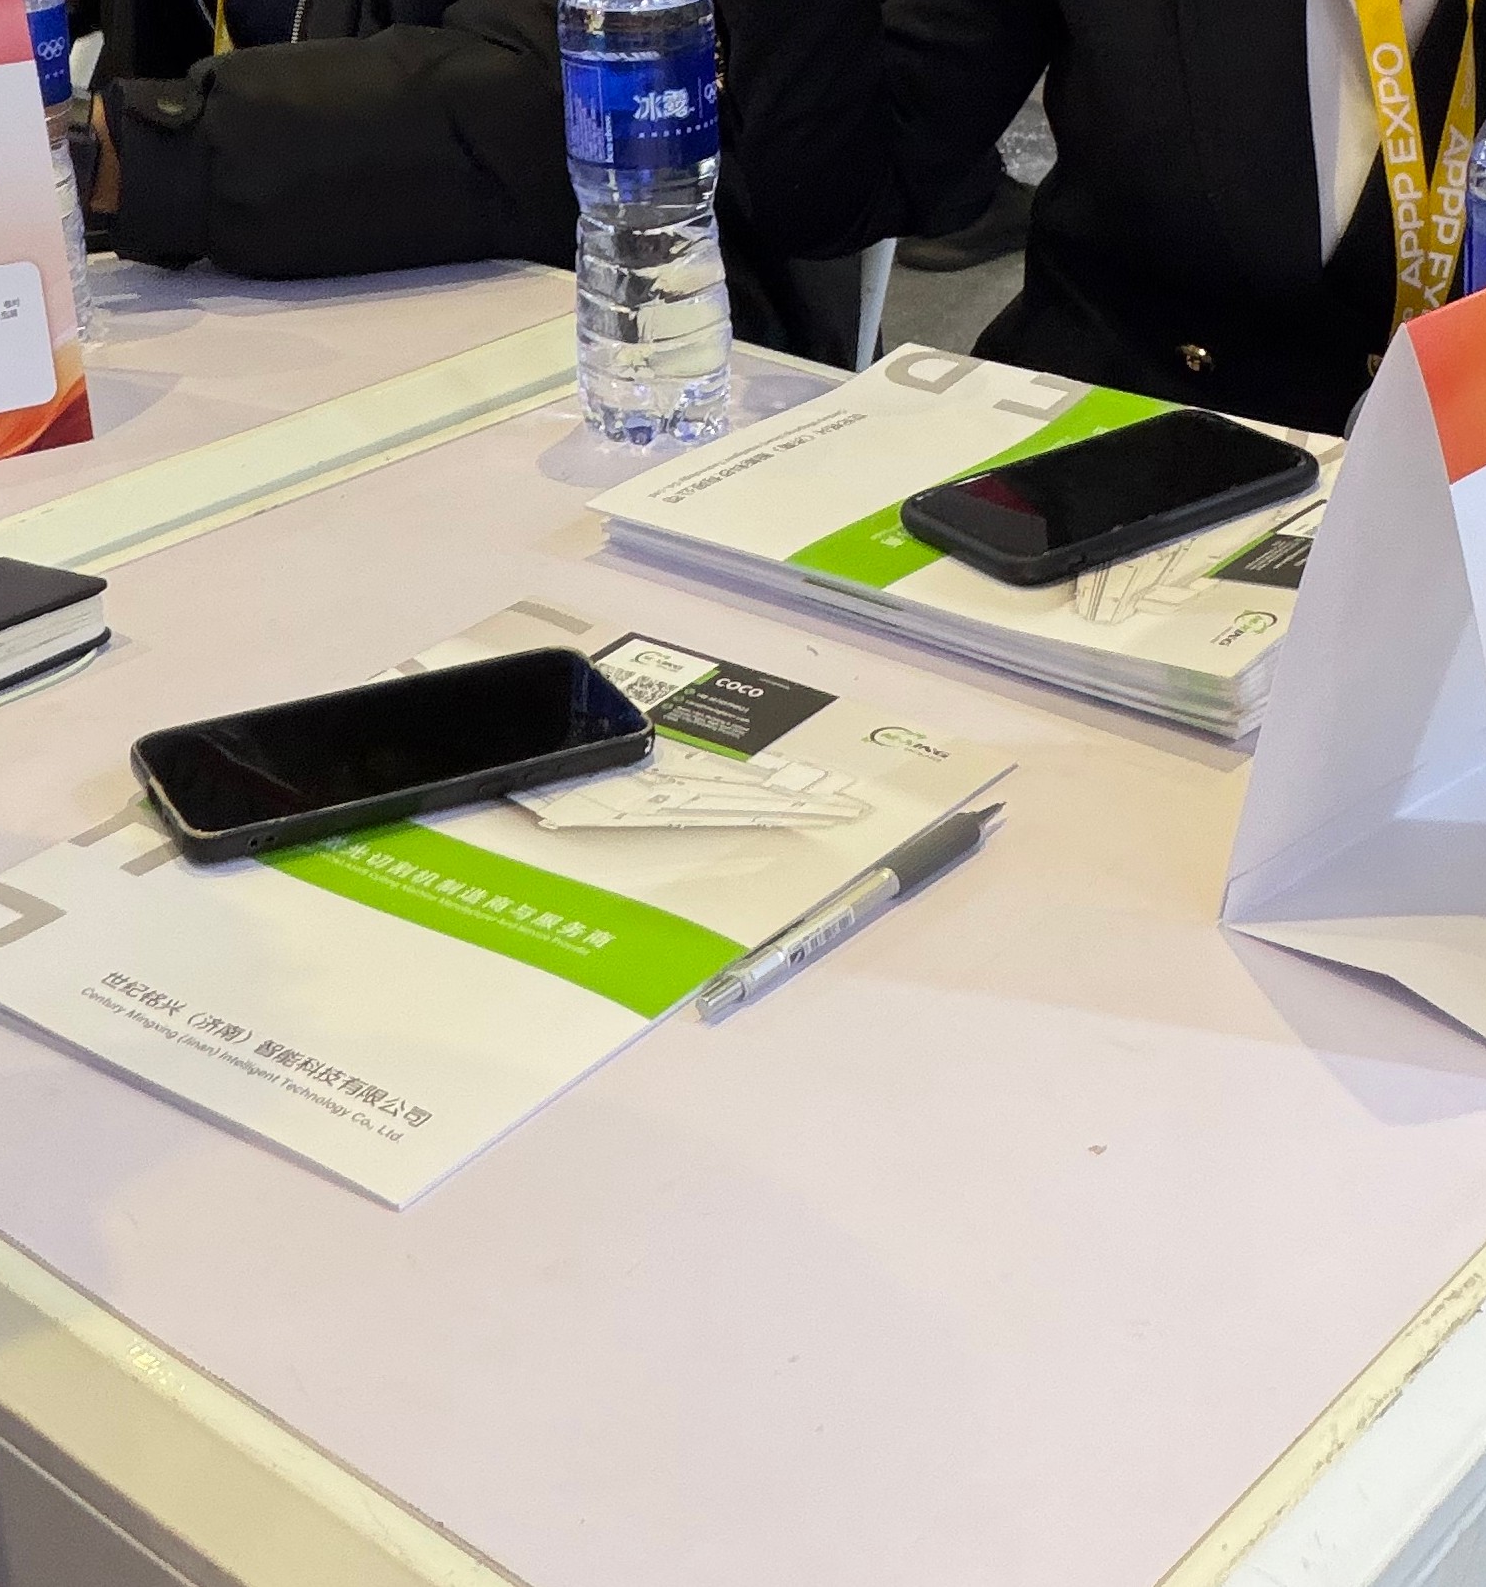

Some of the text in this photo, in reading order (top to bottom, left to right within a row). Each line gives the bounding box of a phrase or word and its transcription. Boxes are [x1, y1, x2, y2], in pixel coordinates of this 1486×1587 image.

[1372, 42, 1425, 289] APPP EXPO
[1432, 123, 1466, 246] APPP
[715, 676, 764, 699] COCO
[80, 986, 125, 1015] Century
[125, 1009, 178, 1040] Mingxing
[219, 1047, 281, 1085] Intelligent
[281, 1077, 351, 1118] Technology
